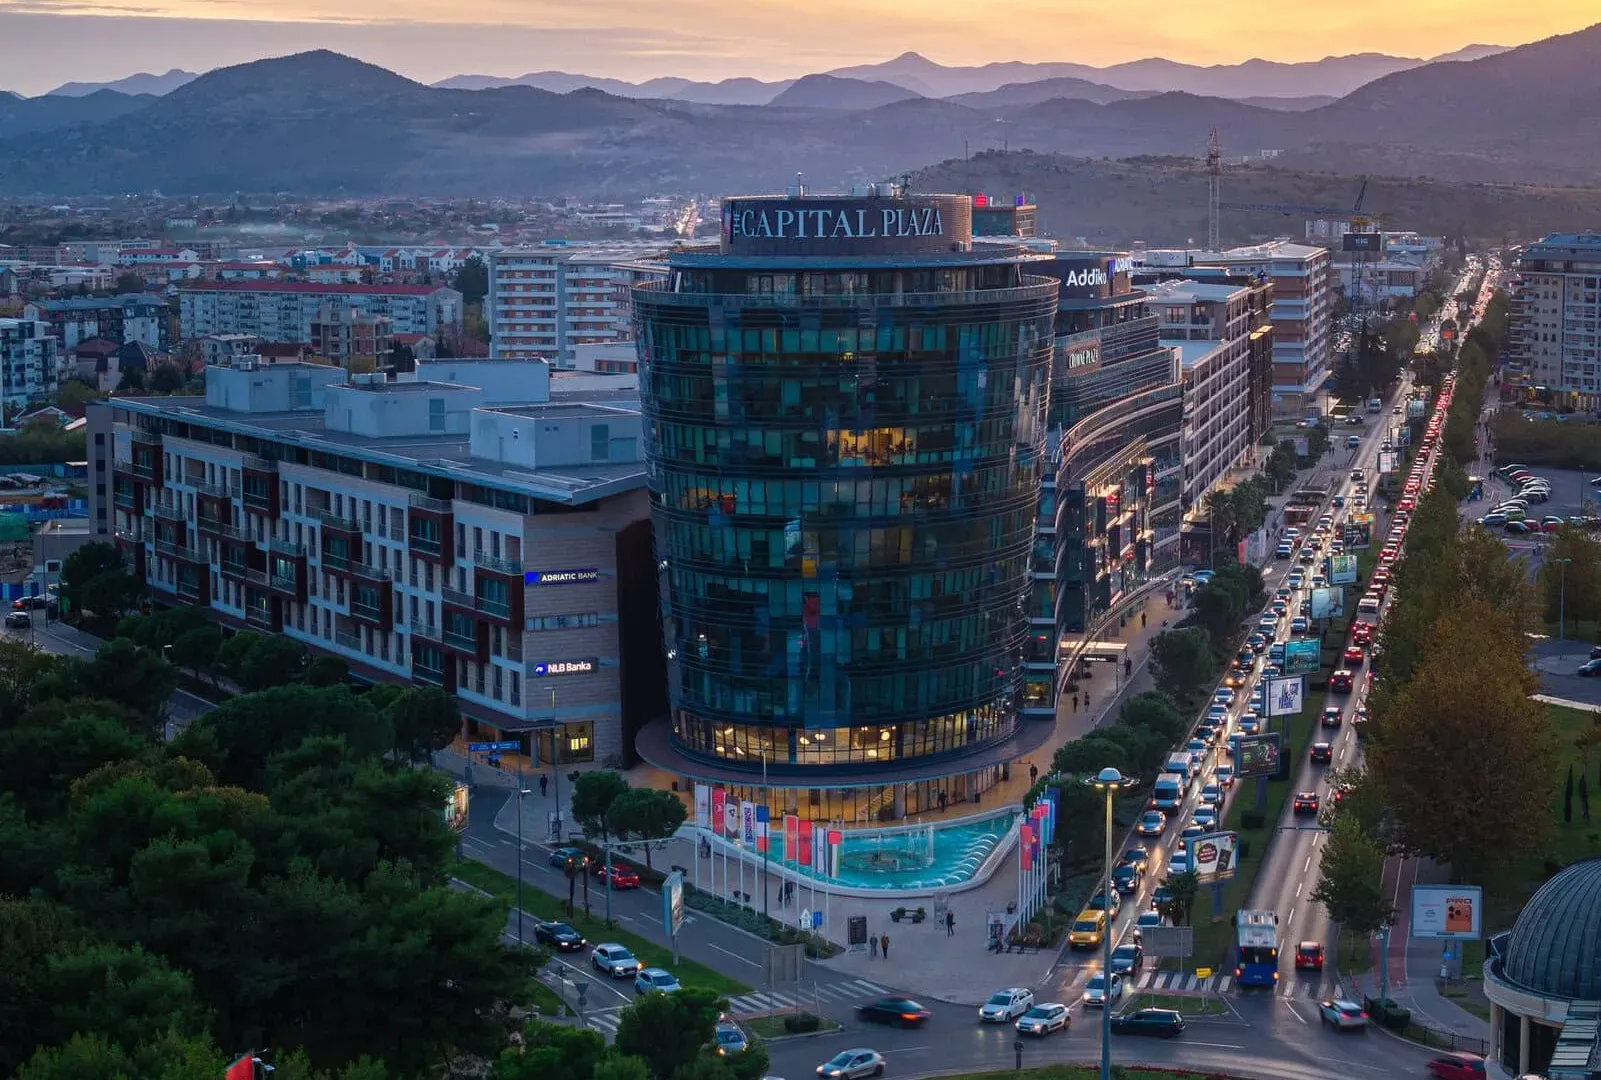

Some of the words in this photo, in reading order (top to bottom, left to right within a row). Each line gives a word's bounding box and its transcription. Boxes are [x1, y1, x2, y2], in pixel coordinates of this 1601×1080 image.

[741, 209, 875, 238] CAPITAL
[881, 208, 943, 236] PLAZA
[1066, 268, 1107, 287] Addiko
[541, 574, 576, 582] ADRIATIC
[578, 571, 598, 579] BANK
[547, 664, 565, 673] NLB
[566, 661, 592, 672] Banka
